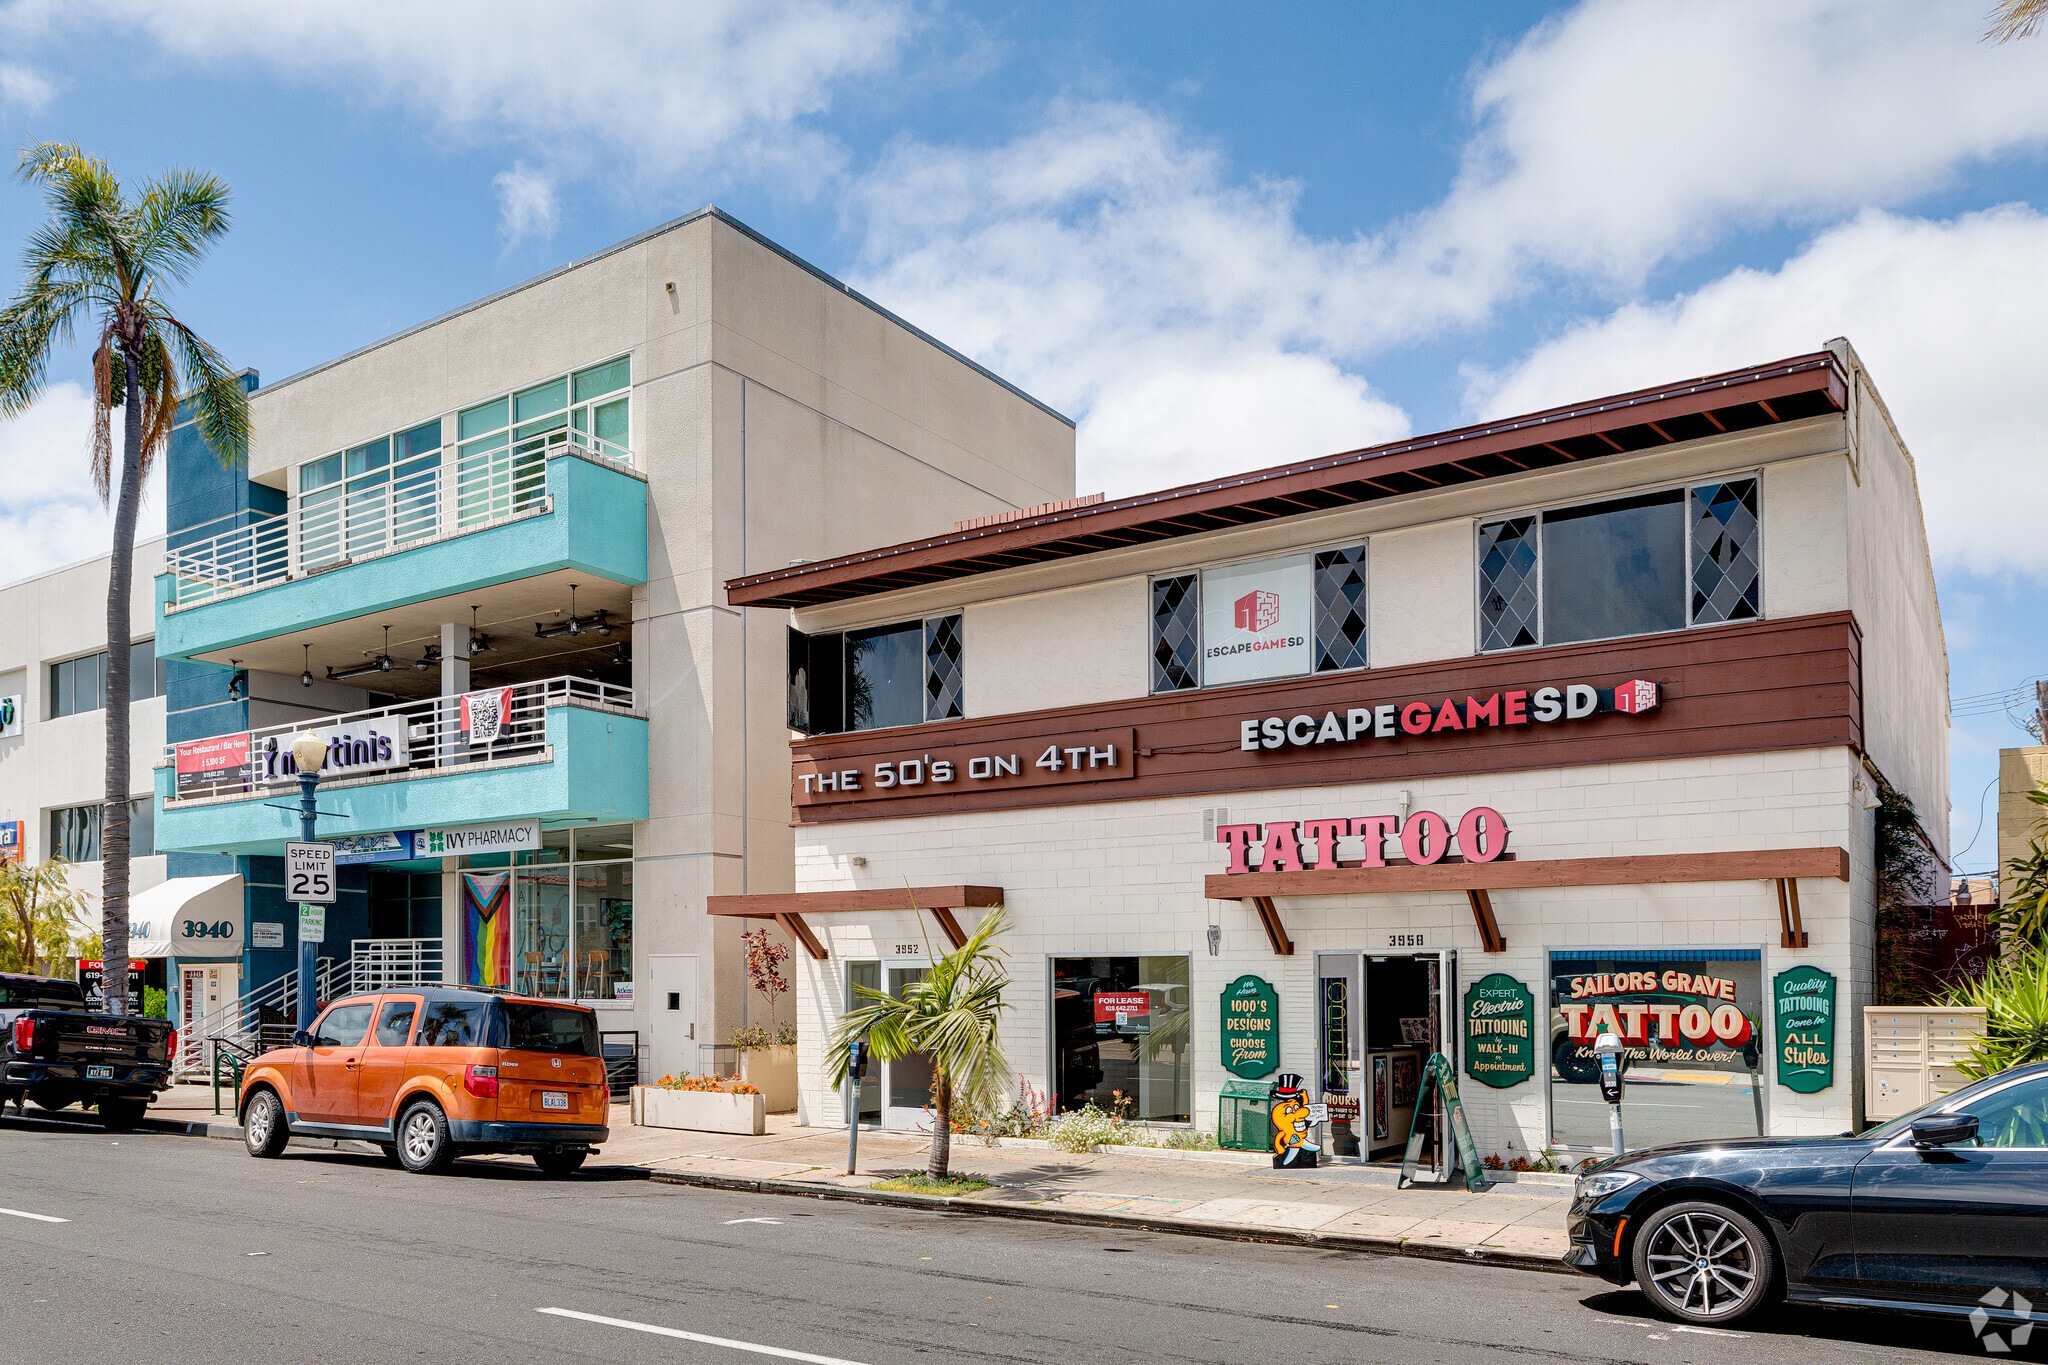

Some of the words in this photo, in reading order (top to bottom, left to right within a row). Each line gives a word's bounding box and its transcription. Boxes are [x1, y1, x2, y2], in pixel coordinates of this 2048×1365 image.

[180, 748, 192, 757] Your
[192, 743, 220, 755] Restaurant
[223, 741, 233, 750] Bar
[218, 755, 227, 765] SF
[798, 769, 862, 794] THE
[968, 753, 1021, 780] ON
[1036, 744, 1118, 772] 4TH
[446, 831, 466, 850] IVY
[468, 826, 532, 847] PHARMACY
[1216, 806, 1513, 875] TATTOO
[290, 849, 331, 860] SPEED
[348, 854, 375, 863] CENTER
[295, 861, 326, 871] LIMIT
[292, 873, 330, 895] 25
[301, 906, 309, 916] 2
[311, 907, 323, 916] HOUR
[181, 919, 234, 939] 3940
[301, 918, 323, 926] PARKING
[1389, 934, 1424, 947] 3958
[895, 944, 919, 955] 3952
[1479, 988, 1517, 998] EXPERT
[1571, 971, 1659, 1000] SAILORS
[1661, 970, 1737, 1003] GRAVE
[1783, 978, 1827, 995] Quality
[1230, 999, 1268, 1013] 1000'S
[1470, 996, 1525, 1018] Electric
[1779, 996, 1830, 1017] TATTOOING
[1226, 1018, 1271, 1032] DESIGNS
[1469, 1019, 1528, 1039] TATTOOING
[1559, 1003, 1751, 1046] TATTOO
[1785, 1018, 1813, 1029] Done
[1813, 1016, 1826, 1026] In
[86, 1025, 127, 1037] GMC
[1327, 981, 1349, 1084] OPEN
[1230, 1038, 1266, 1049] CHOOSE
[1784, 1033, 1826, 1045] ALL
[1477, 1043, 1519, 1054] WALK-IN
[1623, 1047, 1647, 1060] The
[1649, 1048, 1693, 1061] World
[1695, 1049, 1738, 1063] Over!
[1231, 1047, 1268, 1067] From
[1783, 1046, 1830, 1069] Styles
[1473, 1060, 1527, 1073] Appointment
[1326, 1095, 1358, 1106] HOURS
